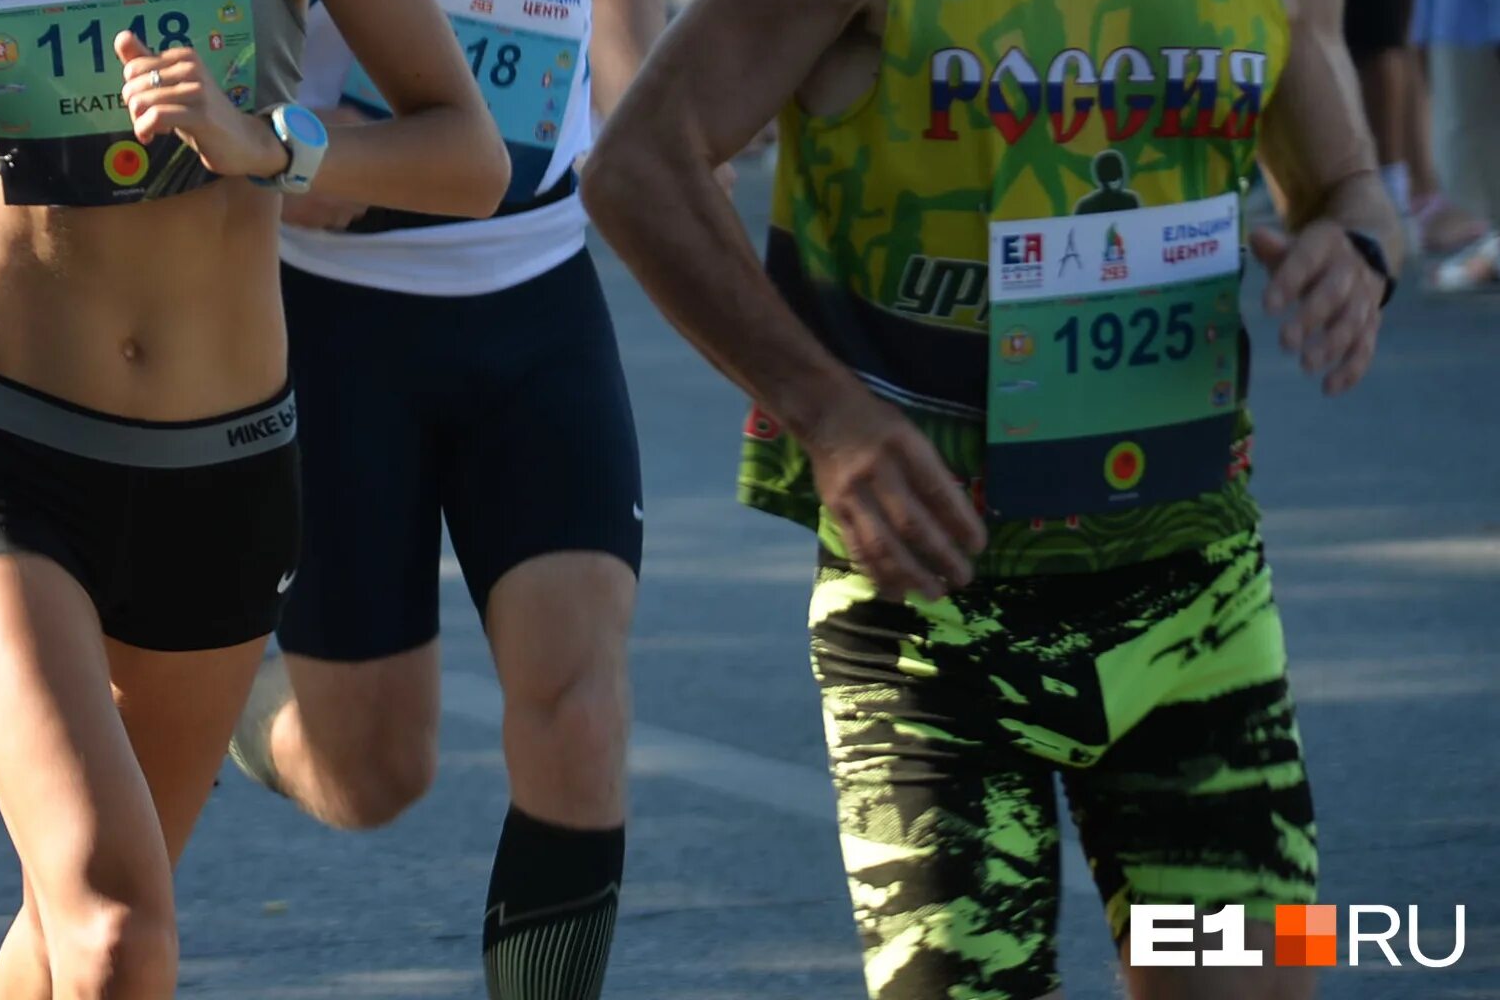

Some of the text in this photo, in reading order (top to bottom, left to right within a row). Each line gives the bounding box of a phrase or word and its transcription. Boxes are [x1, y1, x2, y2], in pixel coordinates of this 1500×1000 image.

[522, 0, 569, 19] ЦЕНТР
[922, 46, 1267, 145] РОССИЯ
[1162, 240, 1220, 264] ЦЕНТР
[895, 255, 989, 322] УР
[1054, 303, 1197, 375] 1925
